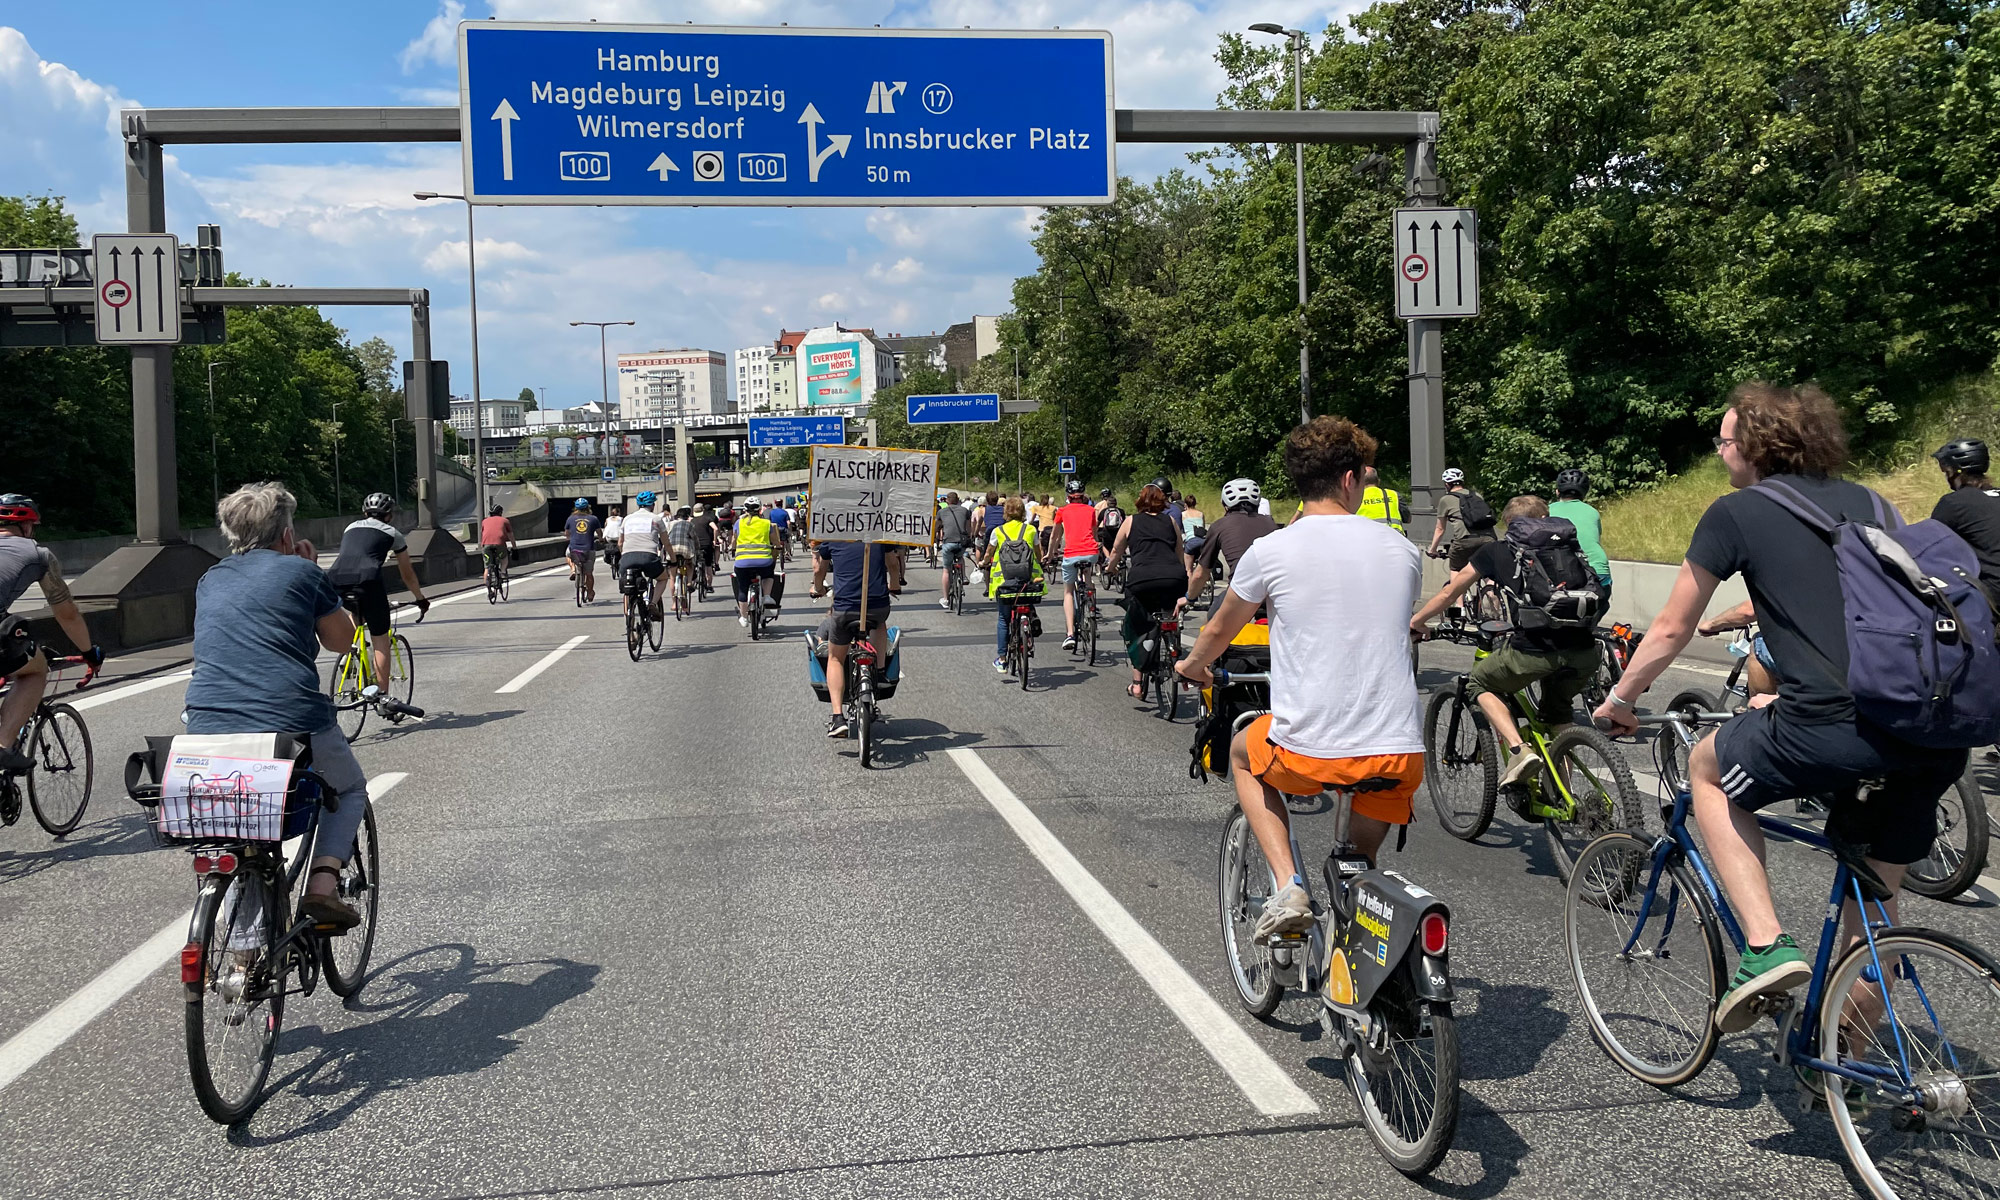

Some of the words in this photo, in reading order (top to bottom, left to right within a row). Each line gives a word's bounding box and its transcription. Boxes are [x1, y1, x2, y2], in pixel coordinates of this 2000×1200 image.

[598, 48, 719, 78] Hamburg
[531, 82, 682, 110] Magdeburg
[694, 83, 785, 112] Leipzig
[928, 90, 946, 107] 17
[577, 115, 744, 138] Wilmersdorf
[865, 127, 1015, 150] Innsbrucker
[1029, 127, 1090, 150] Platz
[568, 157, 601, 175] 100
[747, 158, 778, 176] 100
[867, 165, 889, 182] 50
[893, 170, 911, 182] m
[812, 351, 851, 364] EVERYBODY
[830, 360, 855, 370] HÖRTS.
[975, 398, 994, 406] Platz
[490, 425, 547, 438] ULTRAS
[558, 420, 620, 433] BERLIN
[817, 459, 930, 483] FALSCHPARKER
[858, 491, 883, 507] ZU
[1363, 496, 1393, 505] RESE
[812, 508, 932, 536] FISCHSTÄBCHEN
[1358, 887, 1367, 907] Wir
[1365, 892, 1384, 917] helfen
[1382, 901, 1394, 922] bei
